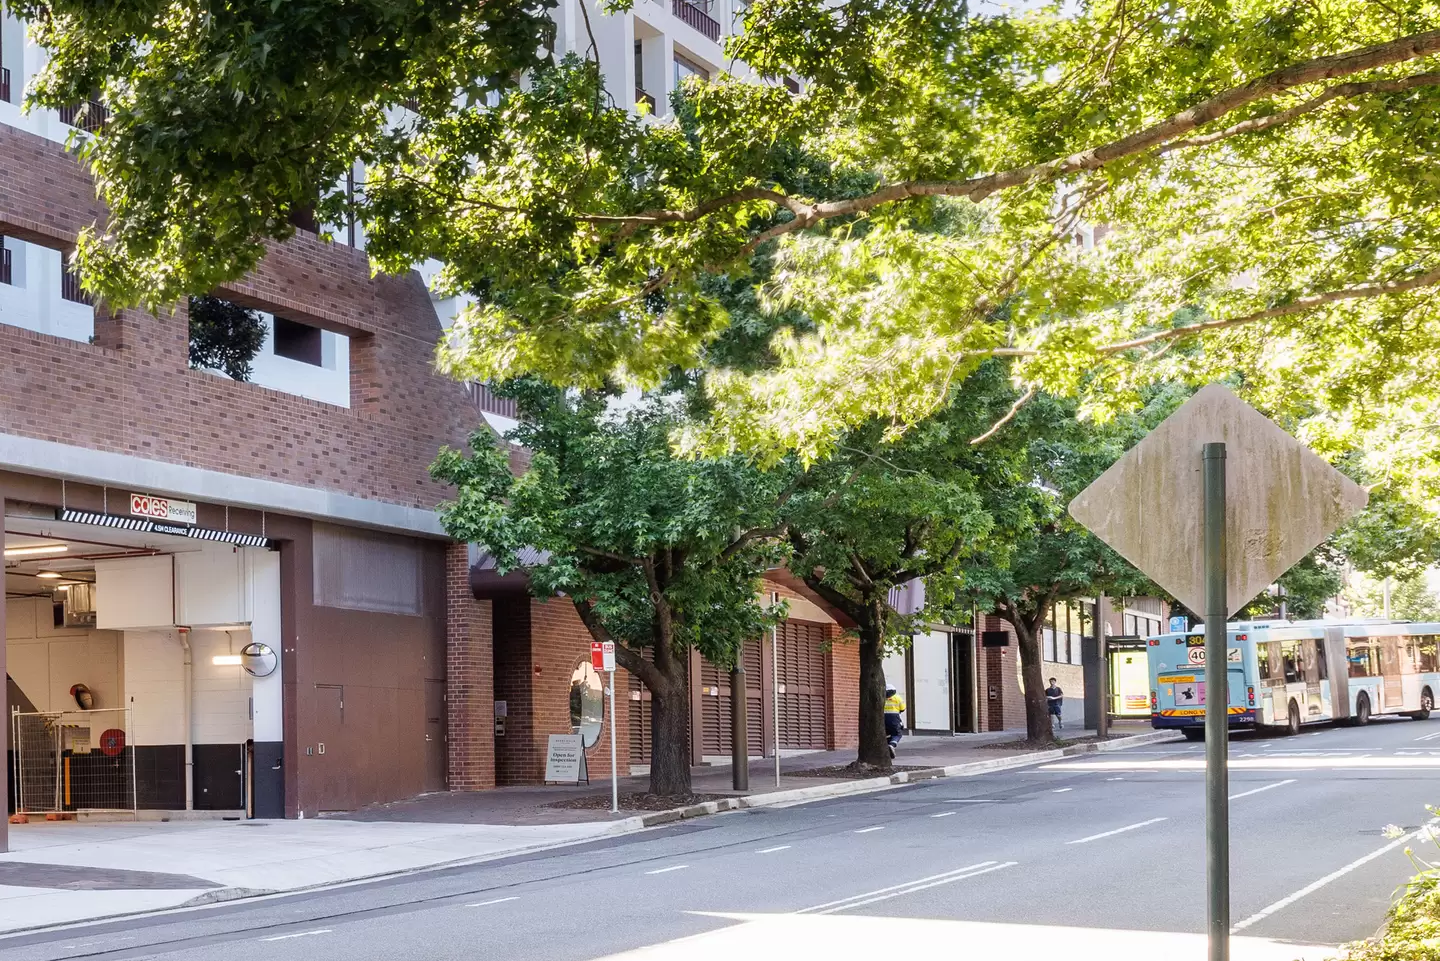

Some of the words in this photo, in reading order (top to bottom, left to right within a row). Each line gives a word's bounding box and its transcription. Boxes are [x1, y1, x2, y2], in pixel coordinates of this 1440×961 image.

[132, 496, 167, 517] coles
[168, 505, 195, 520] Receiving
[164, 525, 188, 536] CLEARANCE
[1191, 651, 1205, 660] 40
